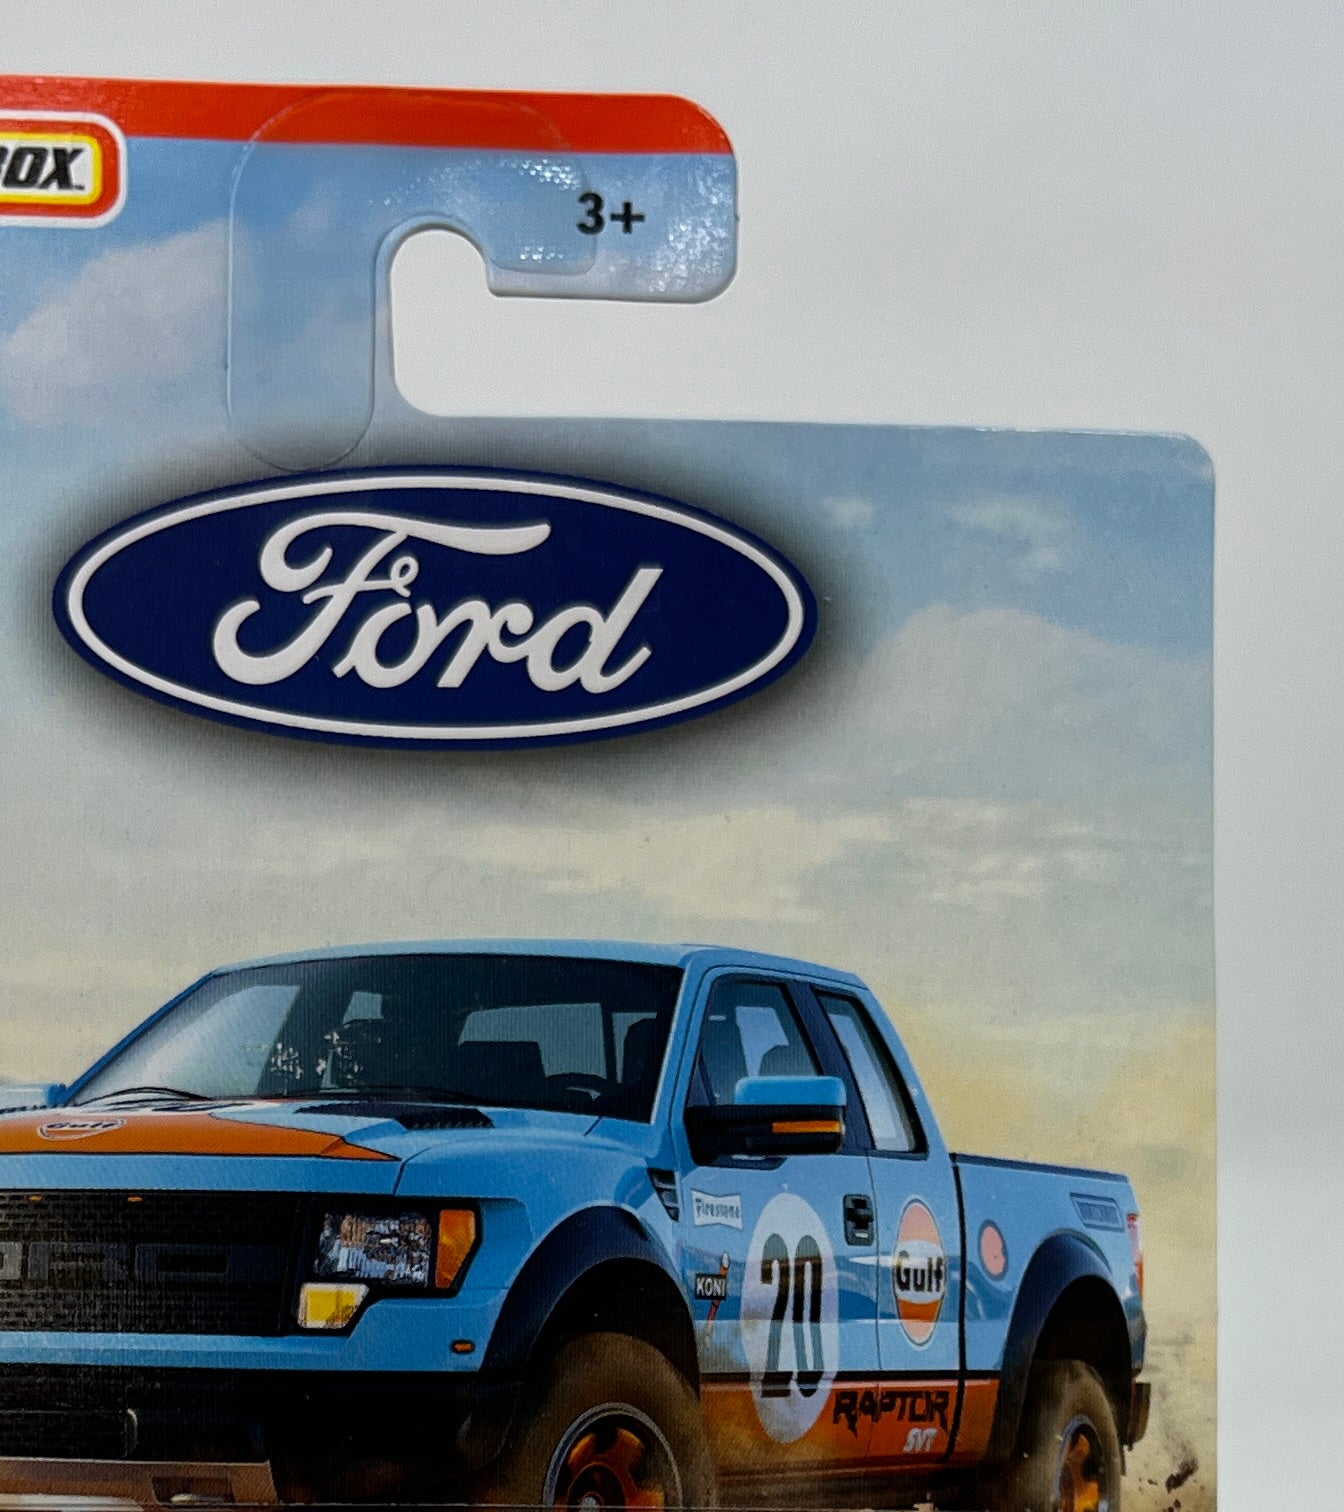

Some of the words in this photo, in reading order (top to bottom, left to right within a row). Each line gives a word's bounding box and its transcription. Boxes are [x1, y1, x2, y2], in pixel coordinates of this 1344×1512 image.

[576, 193, 645, 235] 3+
[213, 511, 664, 694] Ford
[696, 1276, 726, 1298] KONI
[894, 1250, 945, 1292] Gulf
[760, 1233, 824, 1399] 20
[832, 1390, 950, 1438] RAPTOR
[902, 1427, 939, 1453] SVT
